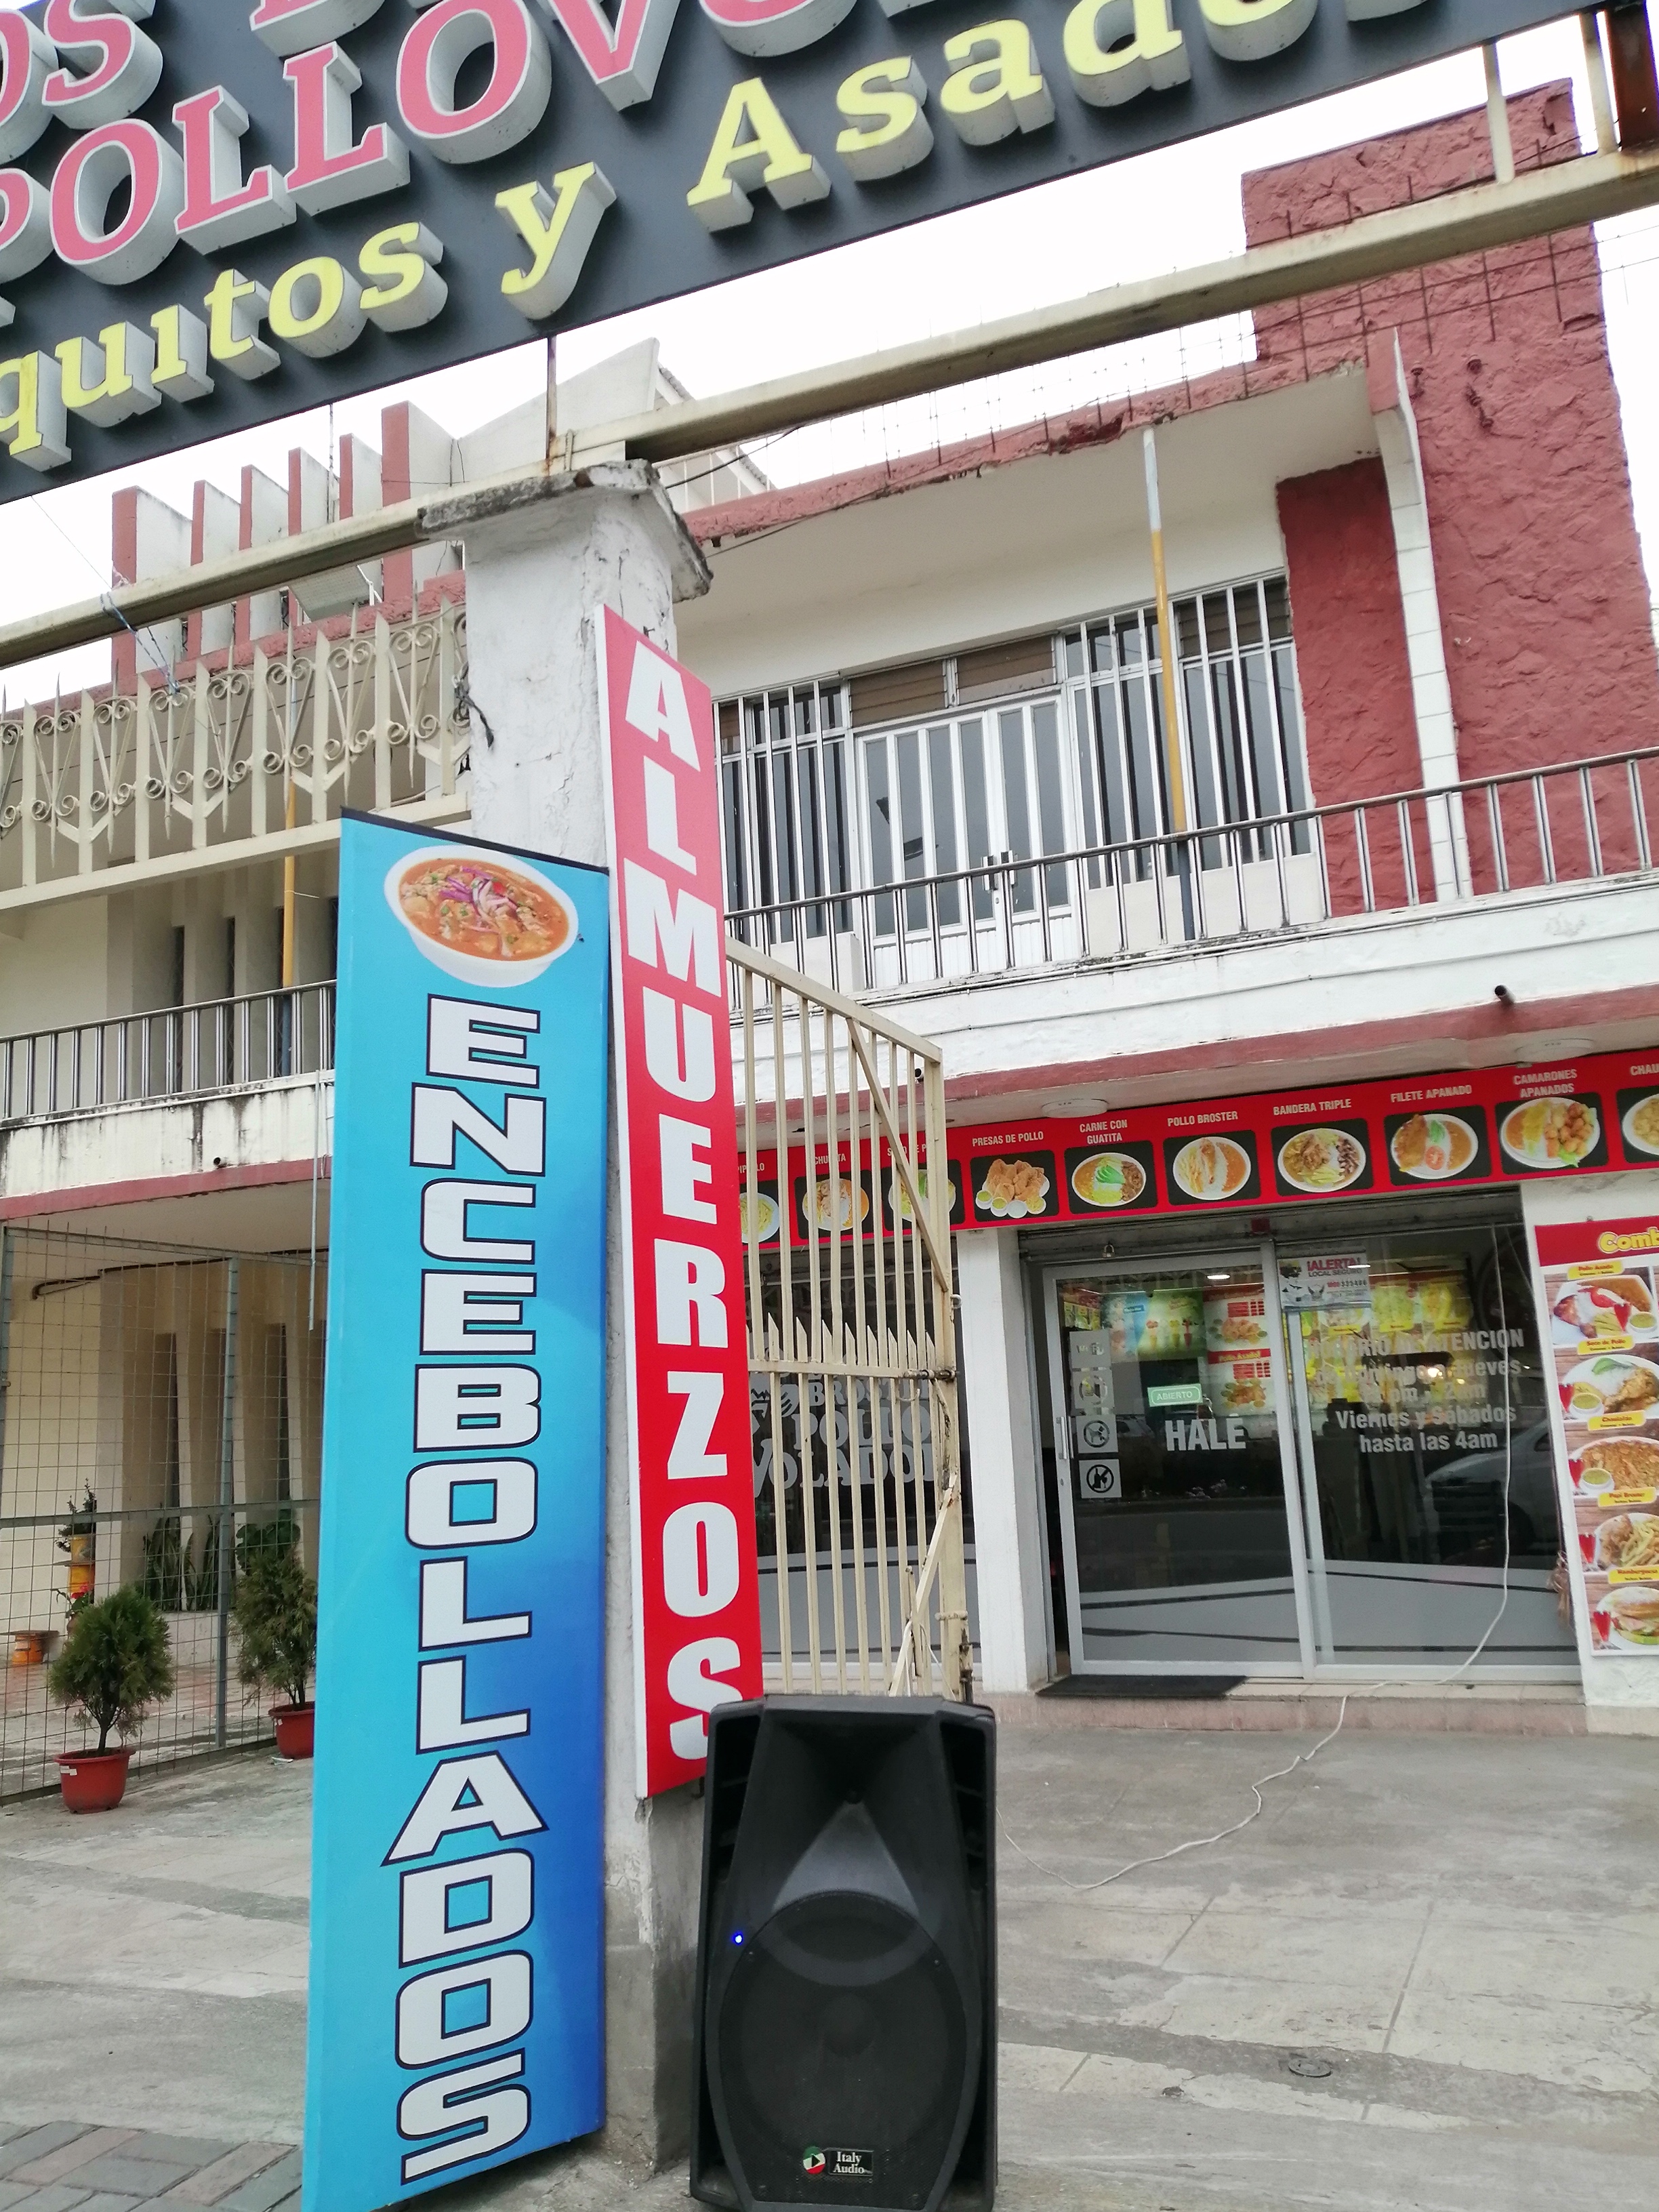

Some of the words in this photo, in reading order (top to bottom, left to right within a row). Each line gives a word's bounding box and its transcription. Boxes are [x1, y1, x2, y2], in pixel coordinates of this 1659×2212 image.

[495, 162, 596, 296] y
[1513, 1069, 1578, 1085] CAMARONES
[1391, 1090, 1423, 1103] FILETE
[1426, 1084, 1472, 1099] APANADO
[1520, 1083, 1575, 1098] APANADOS
[1273, 1103, 1317, 1115] BANDERA
[1319, 1099, 1351, 1111] TRIPLE
[1080, 1121, 1108, 1133] CARNE
[1110, 1120, 1128, 1130] CON
[1168, 1115, 1195, 1126] POLLO
[1197, 1111, 1238, 1124] BROSTER
[972, 1134, 1004, 1147] PRESAS
[1005, 1134, 1017, 1143] DE
[1019, 1131, 1044, 1142] POLLO
[1087, 1132, 1123, 1145] GUATITA
[815, 1153, 846, 1165] CHUTA
[623, 640, 743, 1761] ALMUERZOS
[1156, 1391, 1193, 1401] ABIERTO
[1336, 1410, 1410, 1429] Viernes
[1165, 1418, 1246, 1451] HALE
[1359, 1435, 1414, 1454] hasta
[1420, 1431, 1450, 1451] las
[1455, 1431, 1498, 1450] 4am
[381, 993, 550, 2186] ENCEBOLLADOS
[837, 2151, 861, 2163] Italy
[834, 2163, 864, 2174] Audio
